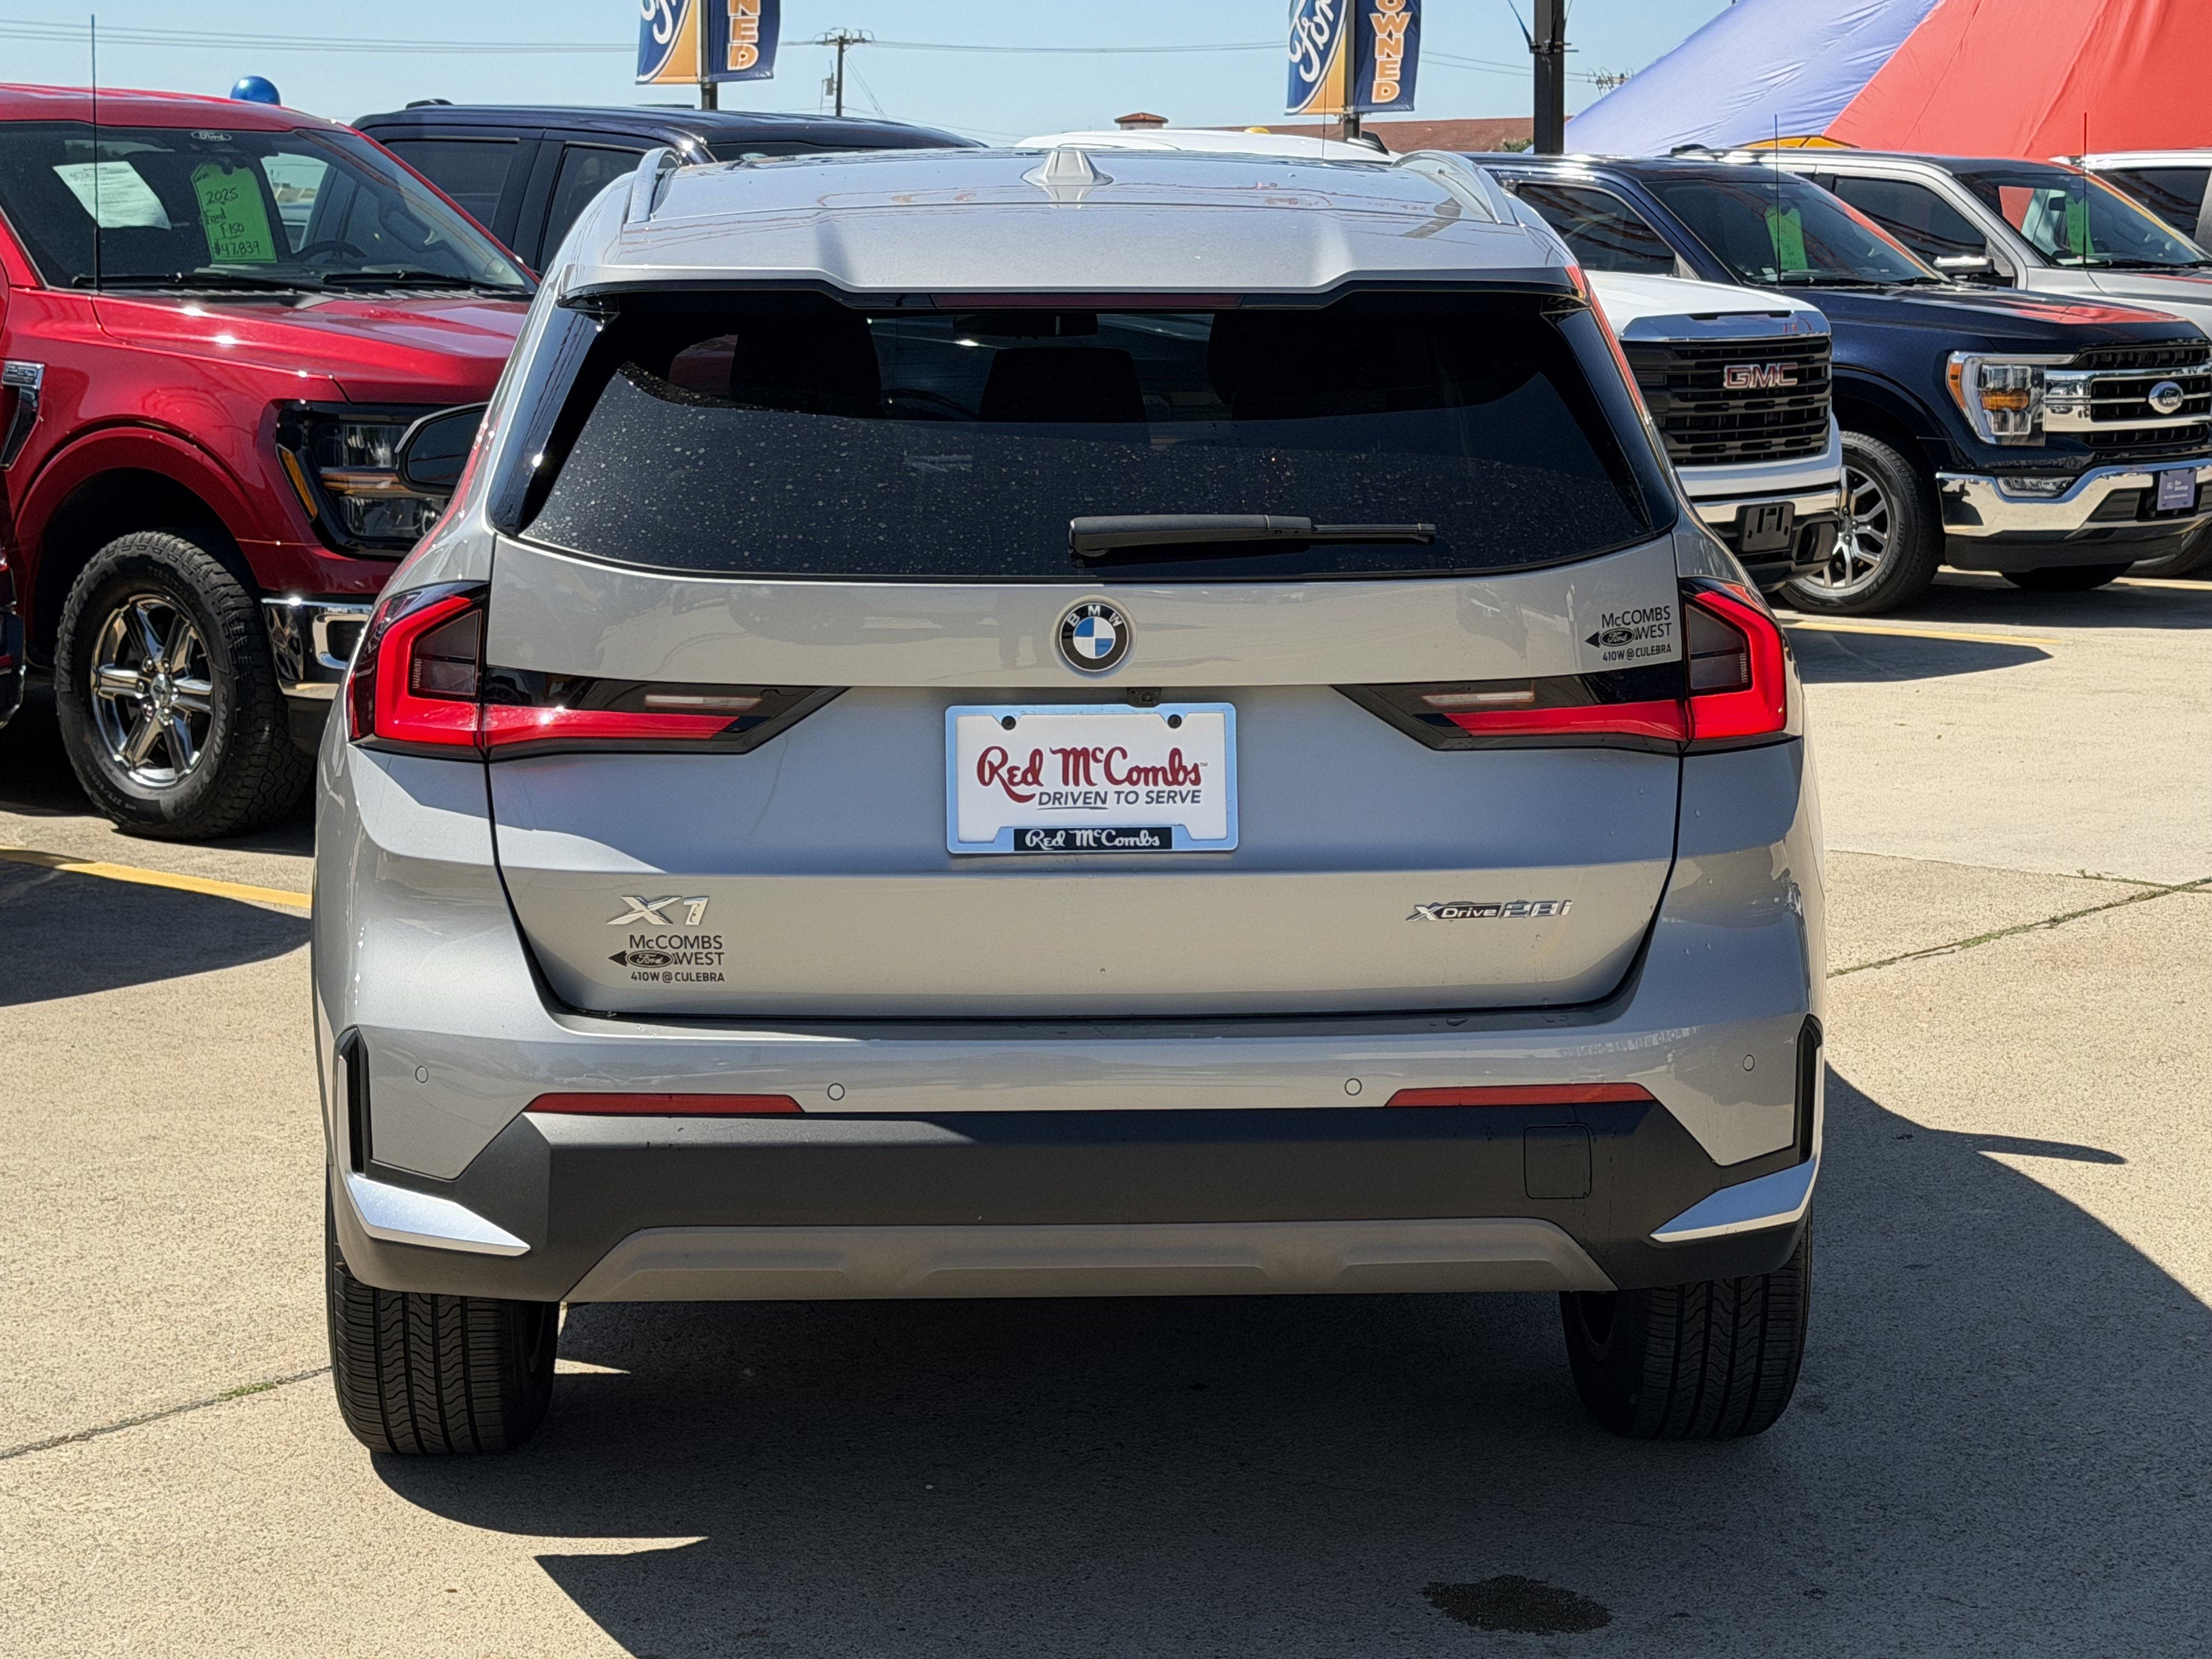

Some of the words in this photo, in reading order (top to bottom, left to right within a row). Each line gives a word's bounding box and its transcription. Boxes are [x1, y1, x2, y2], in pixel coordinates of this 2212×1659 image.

[1288, 0, 1334, 82] For
[205, 188, 239, 205] 2025
[1723, 362, 1798, 389] GMC
[1066, 605, 1123, 627] BMW
[1601, 605, 1671, 628] McCOMBS
[1607, 631, 1629, 643] Ford
[1635, 622, 1672, 640] WEST
[1635, 643, 1672, 658] CULEBRA
[977, 746, 1044, 803] Red
[1049, 746, 1201, 787] McCombs
[1038, 791, 1108, 806] DRIVEN
[1114, 790, 1139, 805] TO
[1144, 789, 1202, 805] SERVE
[1024, 829, 1065, 850] Red
[1068, 829, 1160, 848] McCombs
[605, 895, 709, 926] X1
[629, 934, 723, 950] McCOMBS
[636, 953, 664, 964] Ford
[675, 952, 725, 966] WEST
[630, 972, 659, 982] 410W
[675, 972, 725, 982] CULEBRA
